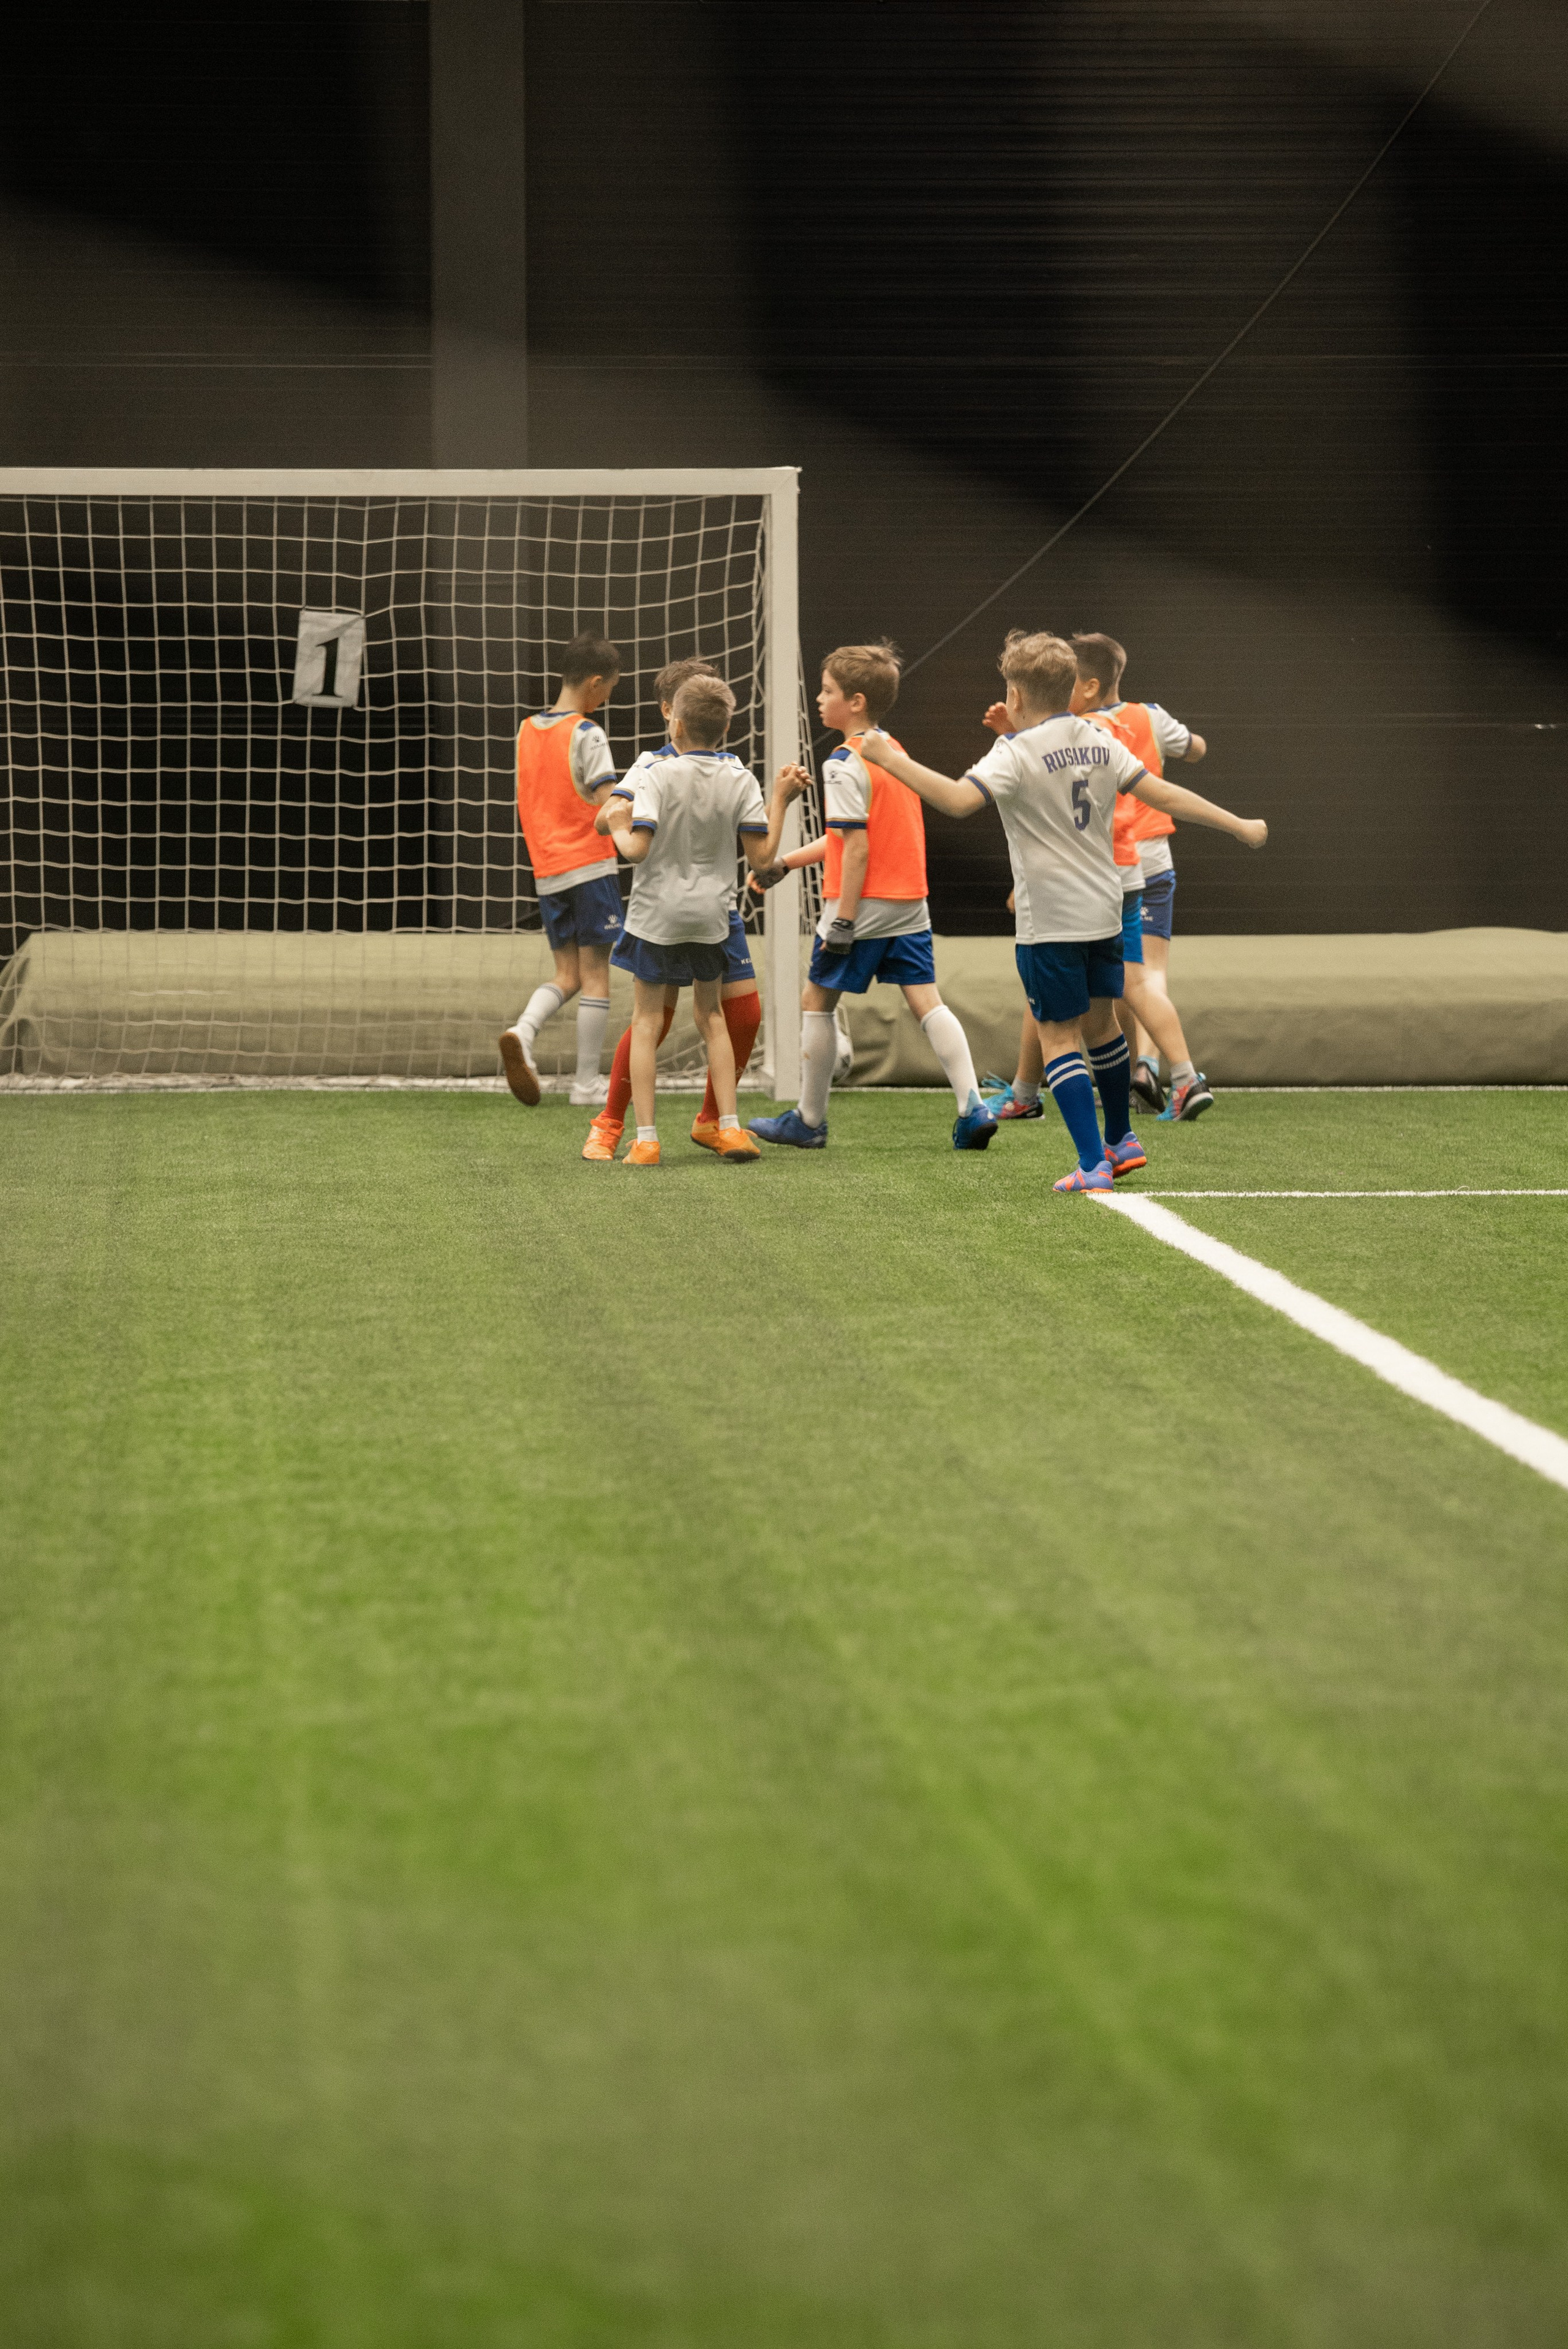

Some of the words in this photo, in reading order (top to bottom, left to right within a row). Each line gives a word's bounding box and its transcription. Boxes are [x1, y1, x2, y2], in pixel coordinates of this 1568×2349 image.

[312, 637, 343, 698] 1
[1042, 746, 1110, 774] RUSAKOV
[1072, 779, 1091, 831] 5
